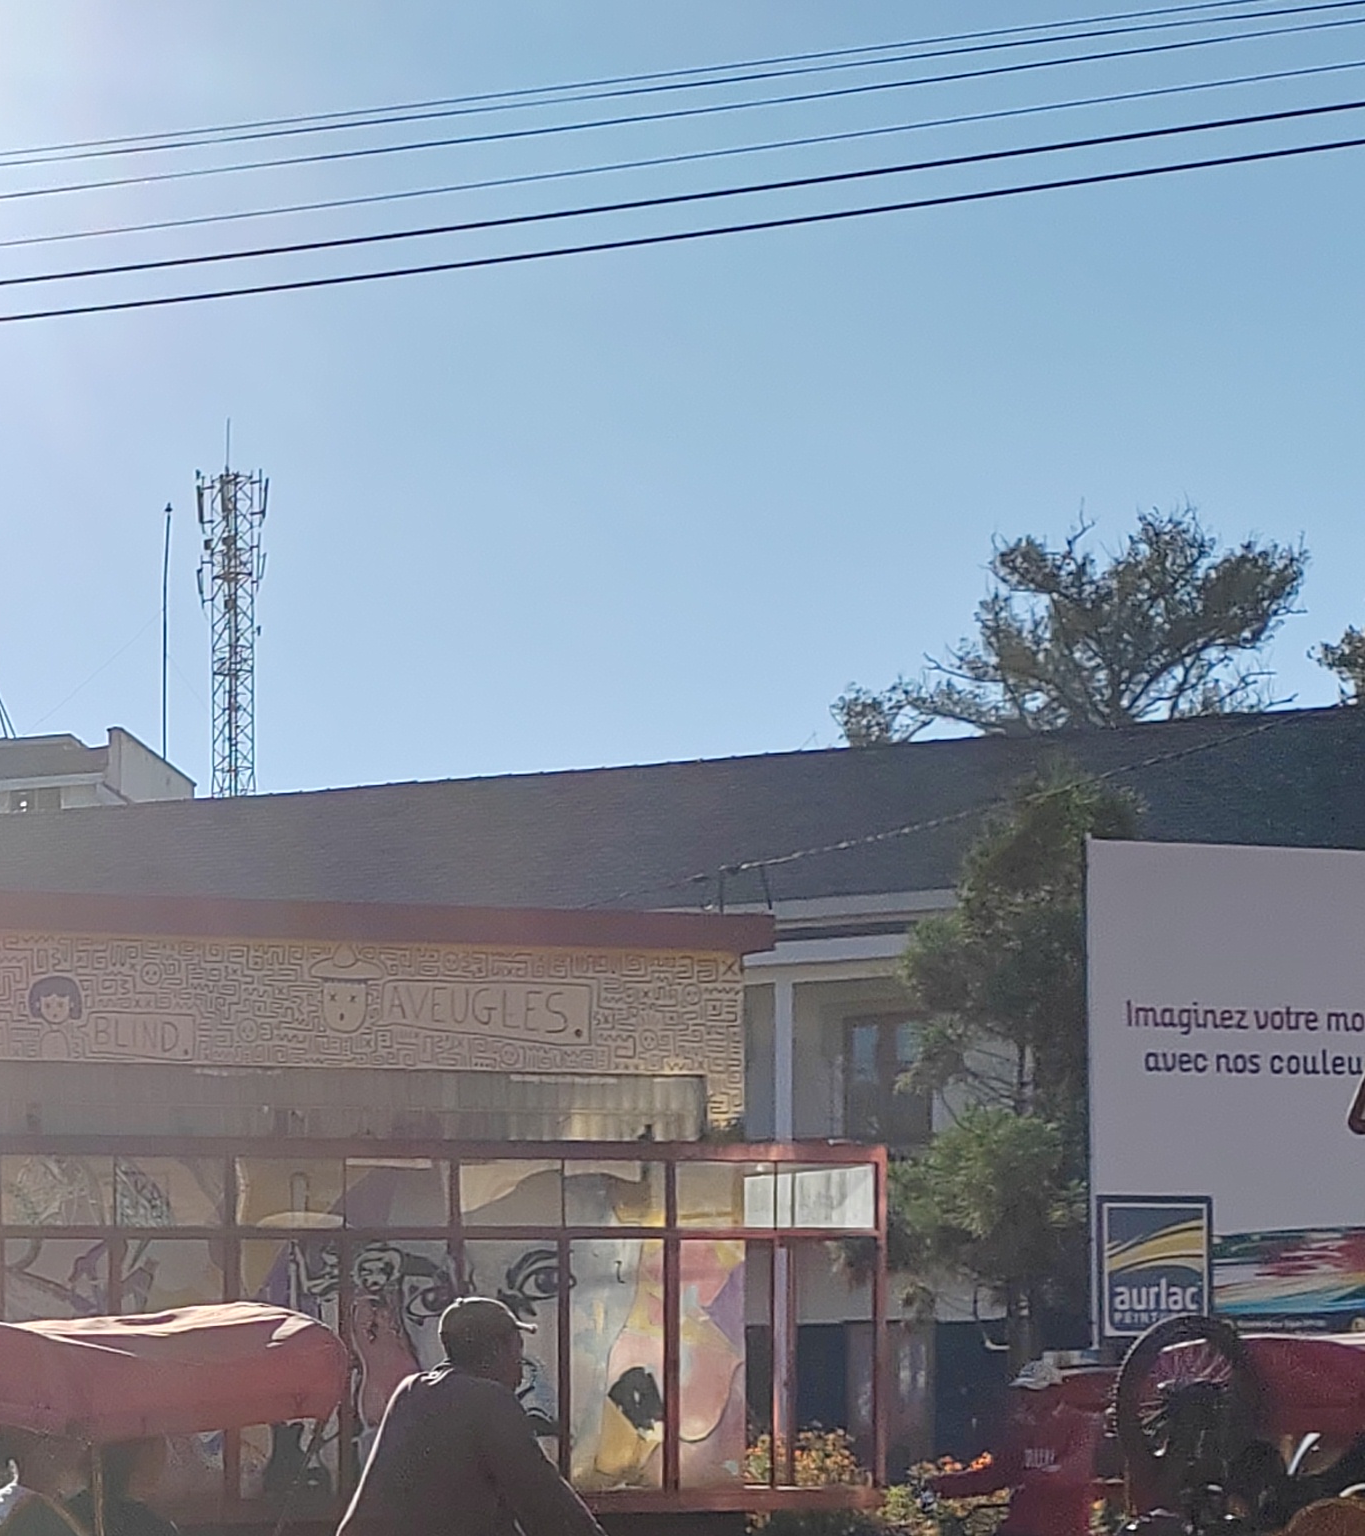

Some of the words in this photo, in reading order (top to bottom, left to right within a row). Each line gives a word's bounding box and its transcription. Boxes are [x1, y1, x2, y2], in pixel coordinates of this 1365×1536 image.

[1126, 1000, 1249, 1035] Imaginez
[1254, 1006, 1319, 1031] votre
[1144, 1051, 1209, 1074] avec
[1216, 1053, 1262, 1075] nos
[1113, 1277, 1199, 1311] aurlac
